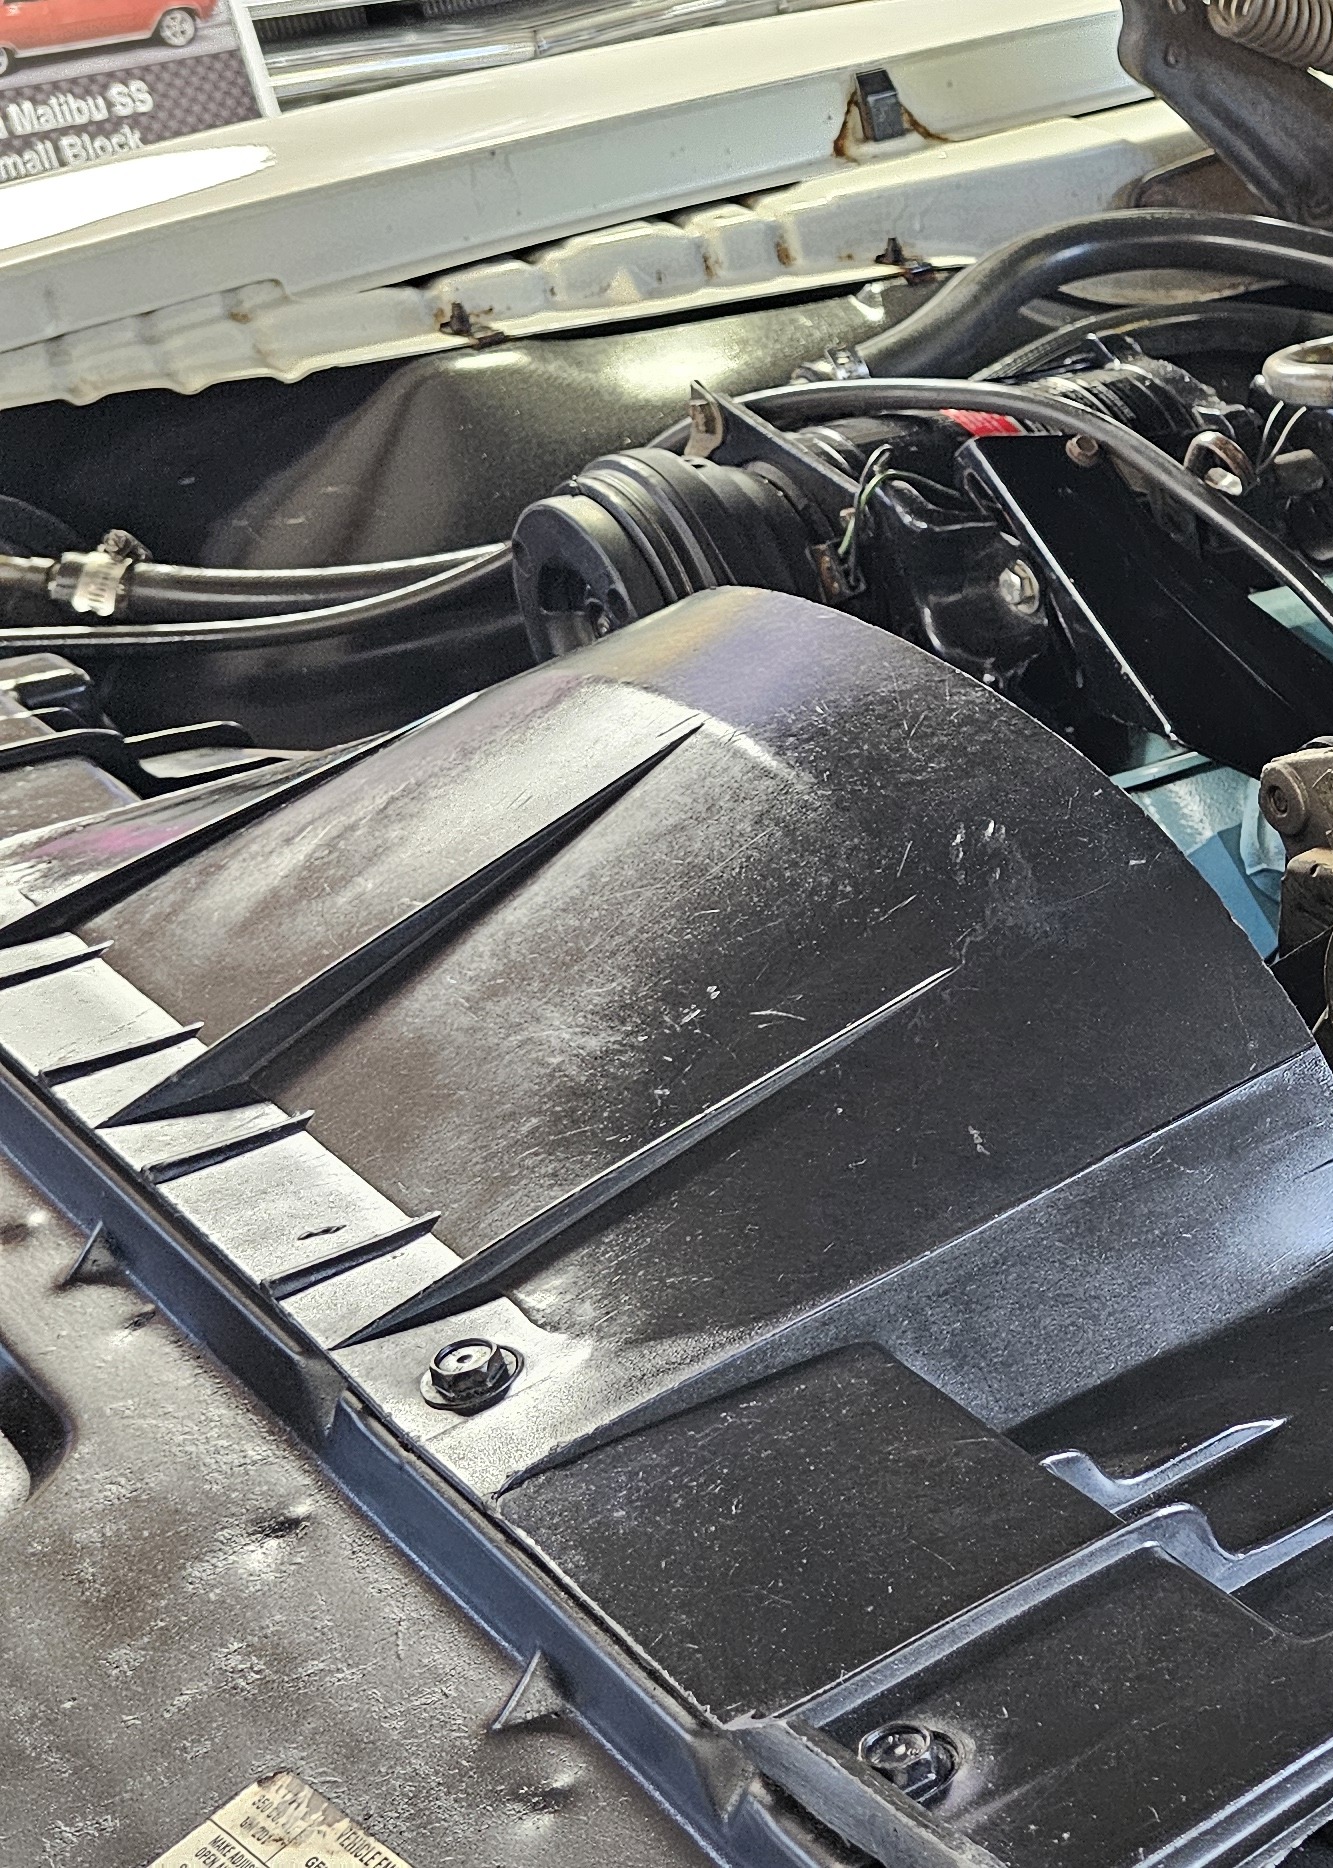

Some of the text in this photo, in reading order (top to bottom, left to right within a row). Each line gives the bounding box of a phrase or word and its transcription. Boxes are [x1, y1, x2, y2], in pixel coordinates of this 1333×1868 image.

[6, 93, 109, 136] Malibu
[105, 79, 154, 117] SS
[58, 123, 145, 166] Block
[208, 1834, 236, 1858] MAKE
